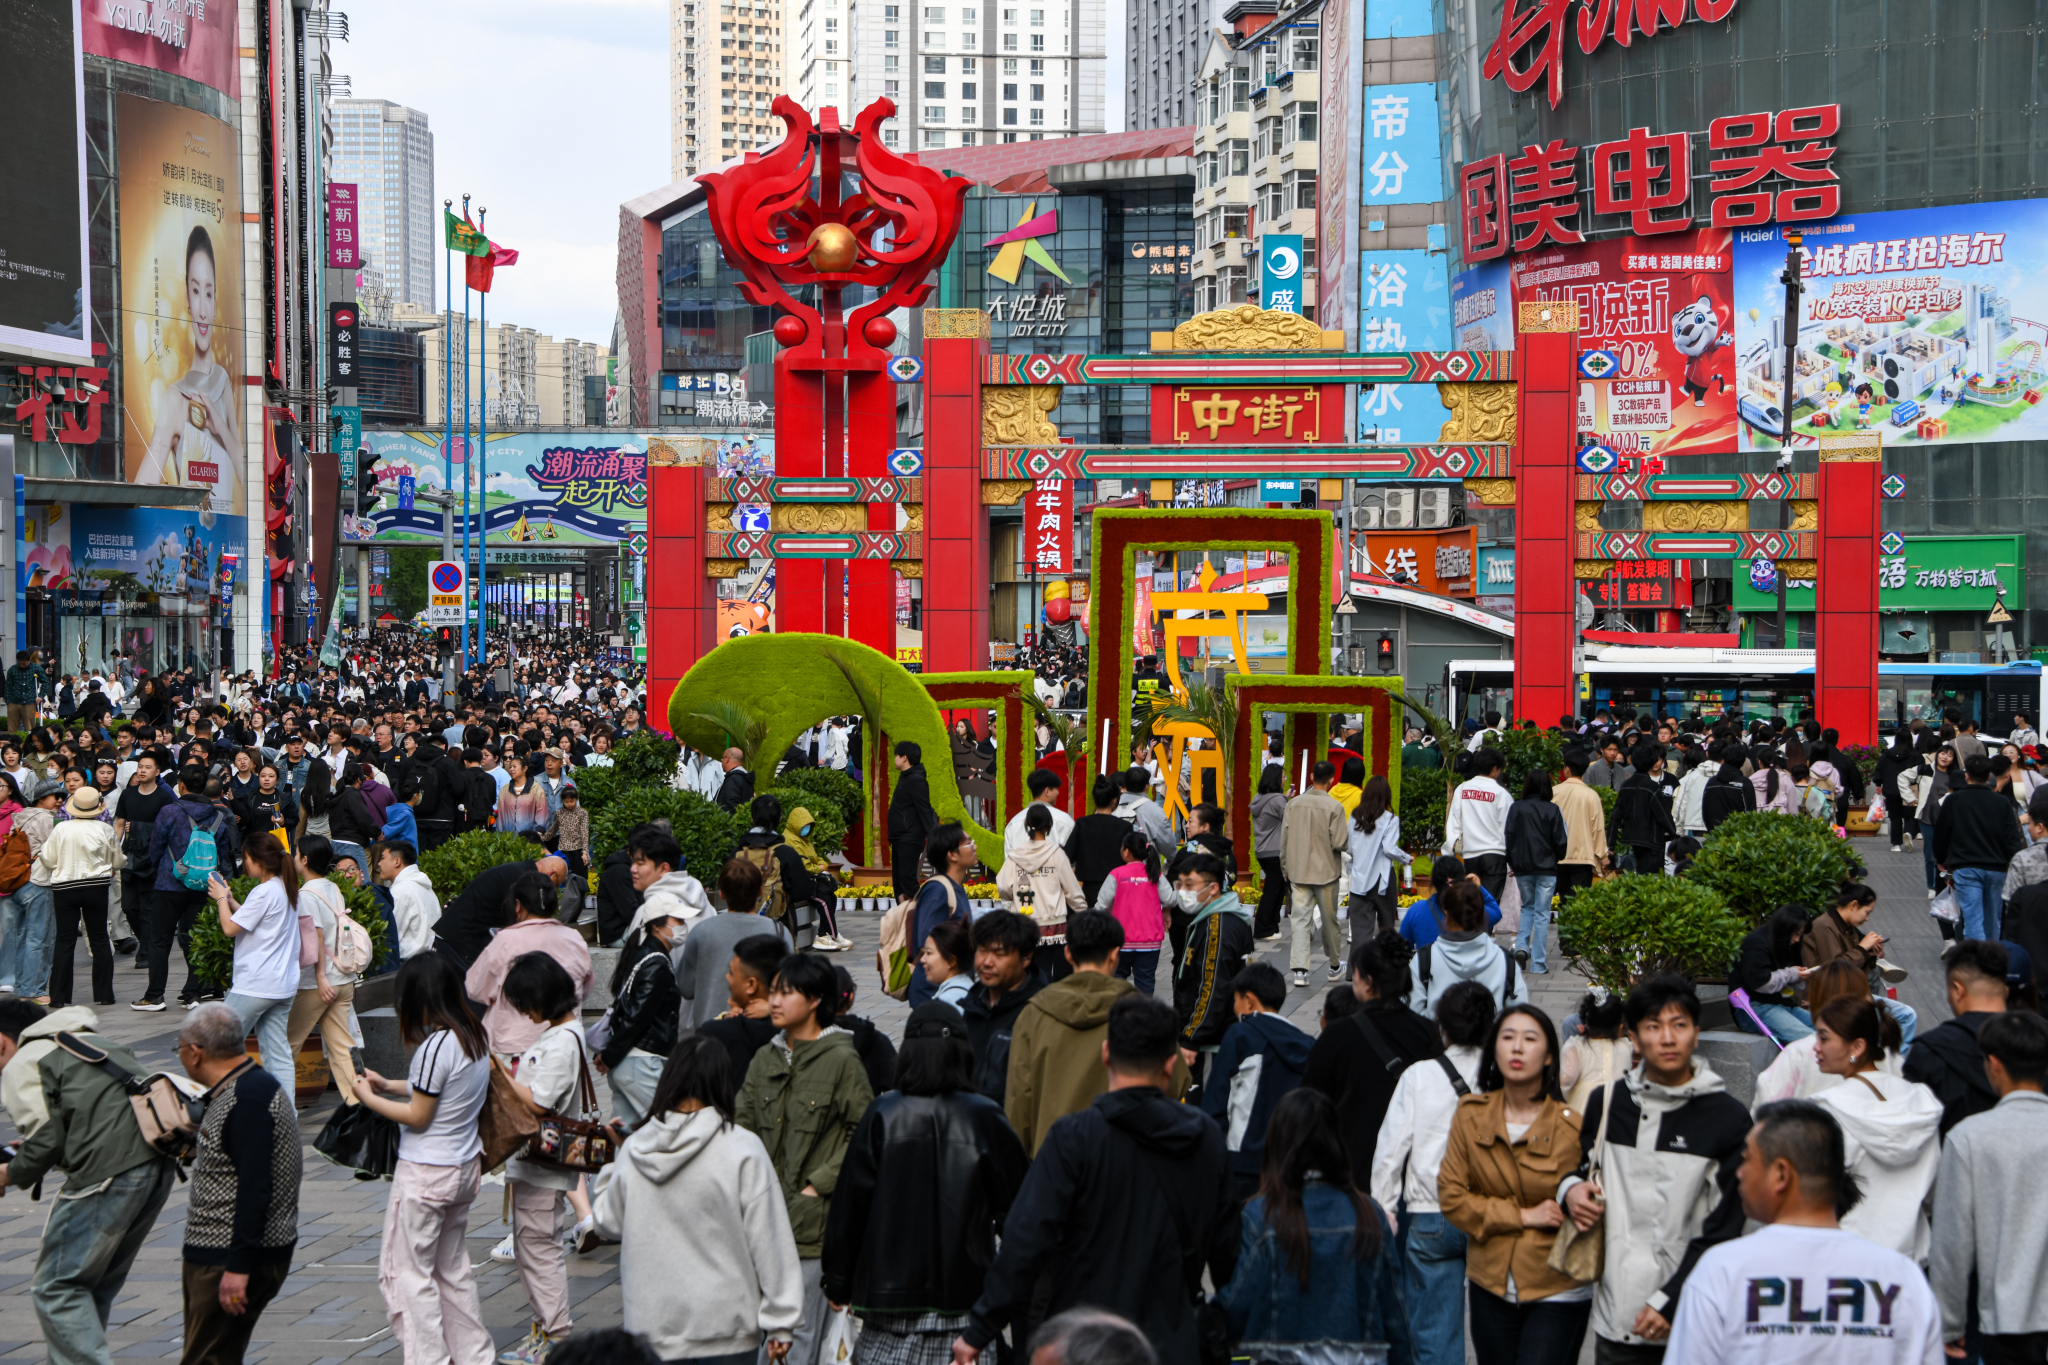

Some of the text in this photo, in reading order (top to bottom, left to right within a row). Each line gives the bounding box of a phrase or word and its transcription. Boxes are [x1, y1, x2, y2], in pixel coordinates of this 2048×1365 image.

[160, 15, 186, 49] 勿扰
[1460, 103, 1841, 264] 国美电器
[335, 207, 353, 263] 新玛特
[1740, 230, 1774, 243] Haier
[1149, 244, 1194, 258] 熊喵来
[1785, 231, 2006, 279] 全城疯狂抢海尔
[1150, 261, 1193, 275] 火锅 5
[1511, 260, 1527, 273] Haier
[1628, 254, 1721, 270] 买家电 选国美佳美!
[986, 294, 1067, 322] 大悦城
[1883, 288, 1962, 316] 10年包修
[1010, 324, 1068, 336] JOY CITY
[338, 330, 352, 375] 必胜客
[1616, 380, 1660, 394] 3C补贴规则
[695, 399, 750, 419] 潮流馆
[1618, 398, 1661, 411] 3C数码产品
[1191, 392, 1304, 441] 中街
[1612, 413, 1668, 425] 至高补贴500元
[378, 443, 407, 454] SHEN
[410, 445, 437, 461] YANG
[497, 448, 524, 456] CITY
[190, 465, 218, 478] CLARINS
[532, 450, 648, 483] 潮流涌聚
[1265, 481, 1295, 490] 东中街店
[88, 533, 134, 547] 巴拉巴拉童装
[85, 547, 138, 561] 入驻新玛特三楼
[1915, 568, 1998, 588] 万物皆可抓
[1626, 581, 1662, 601] 答谢会
[433, 596, 461, 605] 严管路段
[433, 607, 461, 617] 小东路
[1462, 790, 1496, 802] ENGLAND
[1746, 1275, 1901, 1325] PLAY
